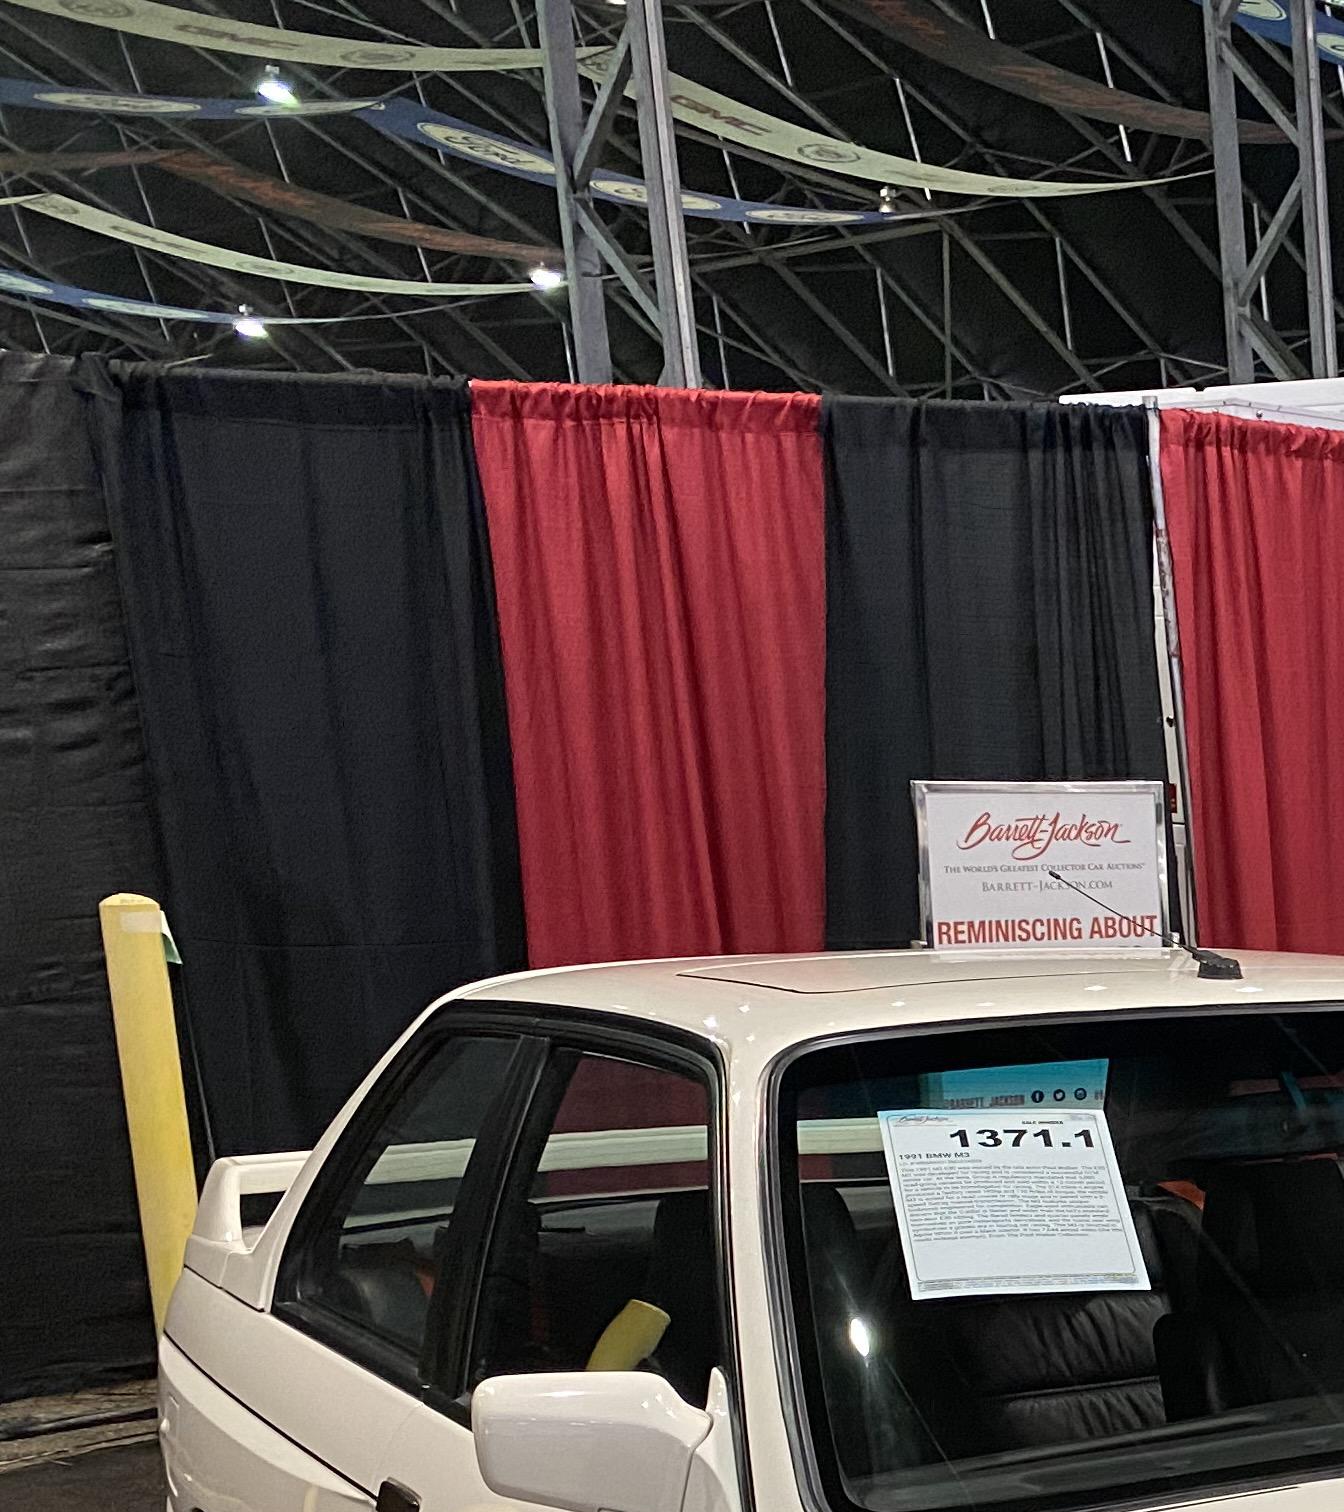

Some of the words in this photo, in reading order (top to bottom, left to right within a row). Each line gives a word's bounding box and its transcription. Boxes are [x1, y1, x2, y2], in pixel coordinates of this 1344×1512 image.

[443, 135, 535, 164] Ford
[956, 811, 1131, 861] Barrett-Jackson
[943, 864, 961, 874] THE
[937, 917, 1083, 945] REMINISCING
[1089, 914, 1158, 939] ABOUT
[949, 1128, 1095, 1149] 1371.1
